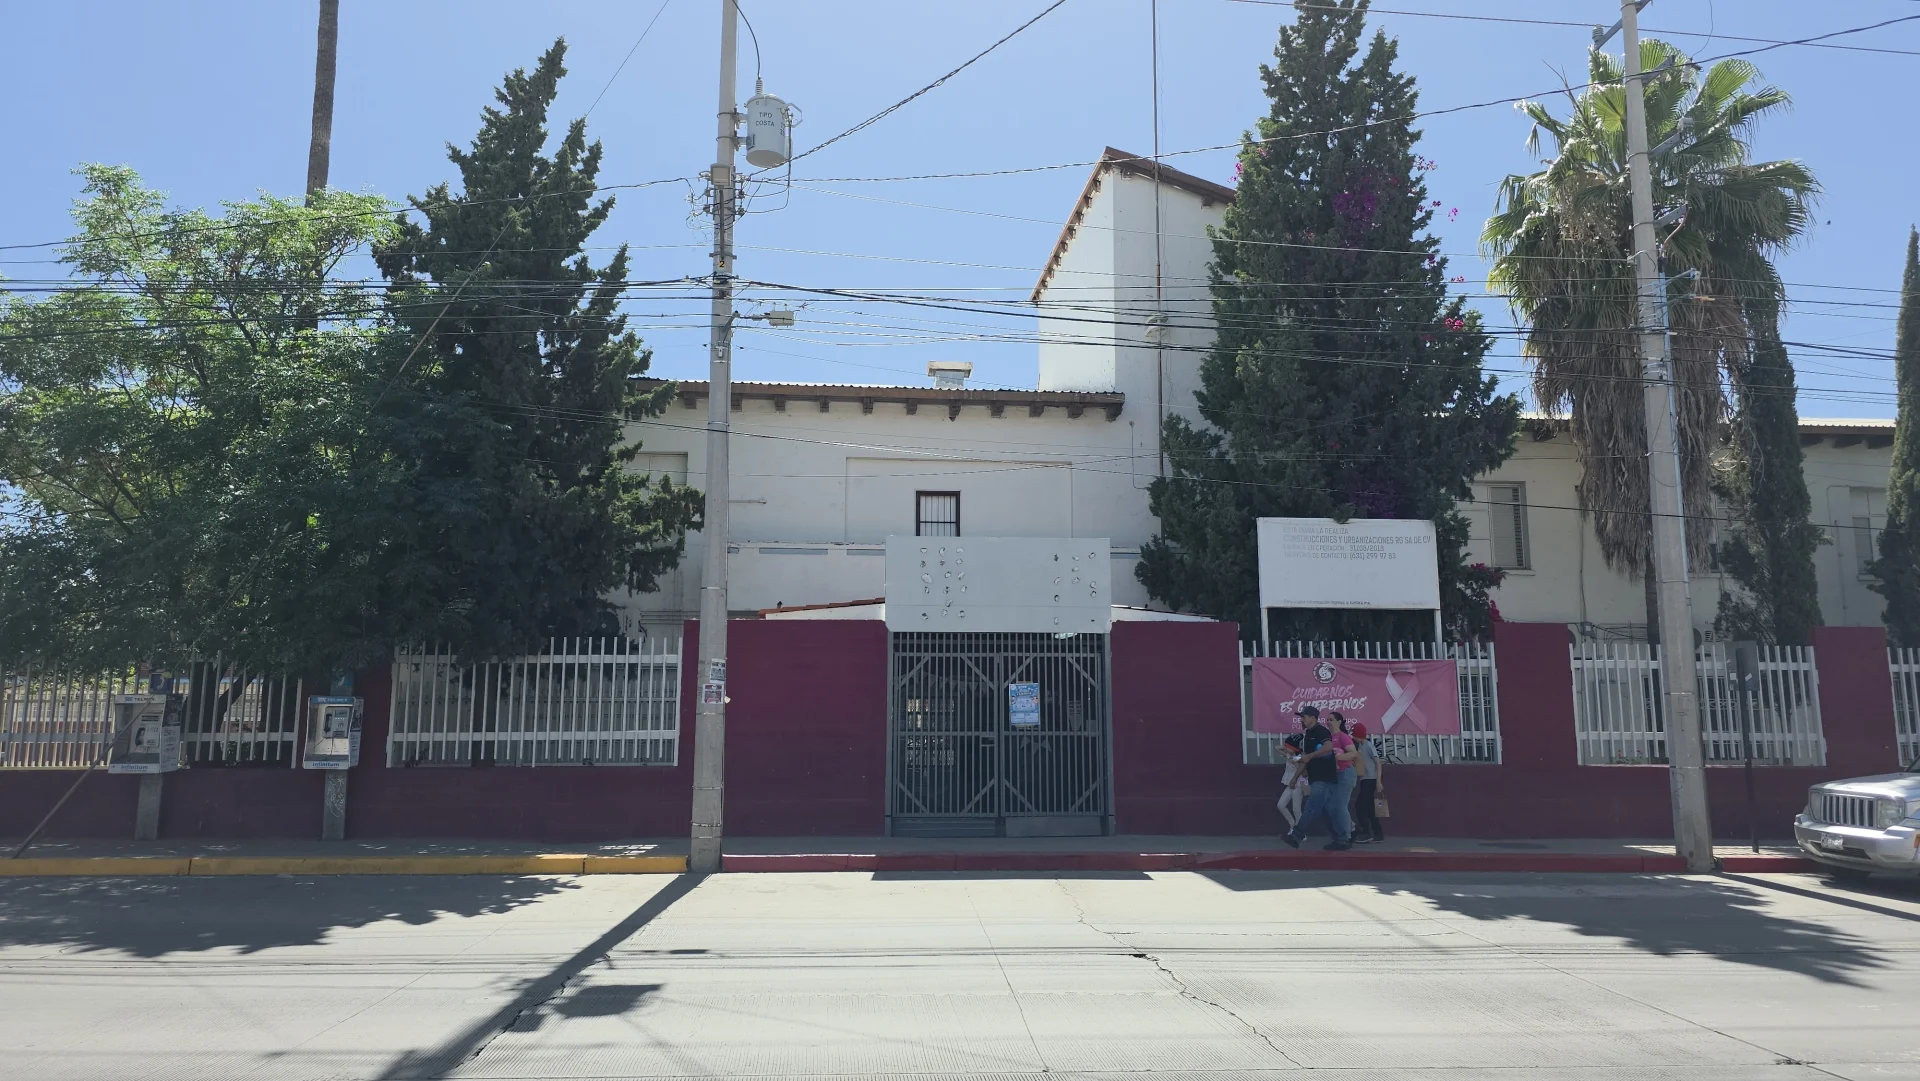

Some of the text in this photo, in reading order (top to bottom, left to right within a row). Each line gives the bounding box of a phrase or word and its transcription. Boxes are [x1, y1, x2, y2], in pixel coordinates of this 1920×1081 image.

[719, 260, 725, 268] 2
[1283, 534, 1338, 544] CONSTRUCCIONES
[1338, 535, 1343, 544] Y
[1343, 535, 1394, 544] URBANIZACIONES
[1404, 536, 1413, 544] SA
[1413, 536, 1422, 544] DE
[1422, 535, 1431, 544] CV
[1366, 552, 1378, 560] 299
[1379, 552, 1387, 560] 97
[1291, 684, 1354, 700] CUIDARNOS
[1279, 700, 1295, 713] ES
